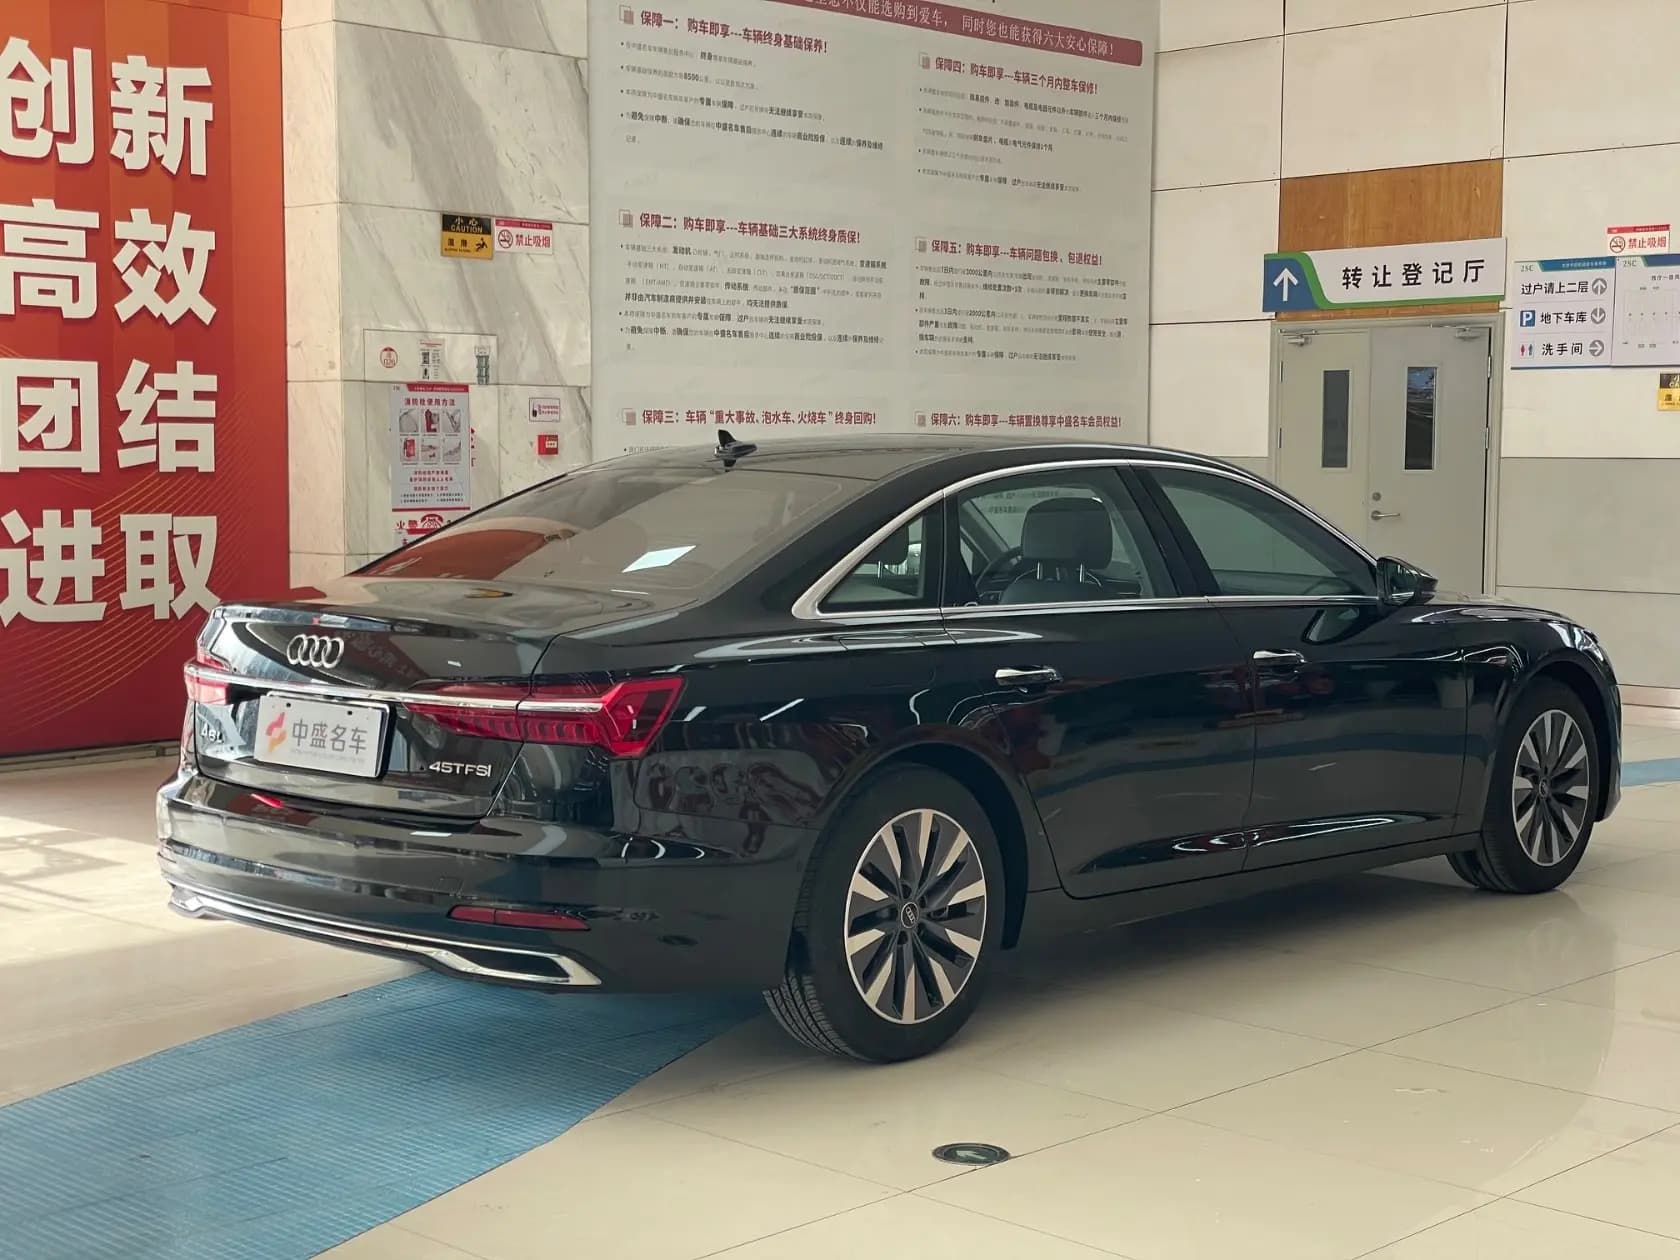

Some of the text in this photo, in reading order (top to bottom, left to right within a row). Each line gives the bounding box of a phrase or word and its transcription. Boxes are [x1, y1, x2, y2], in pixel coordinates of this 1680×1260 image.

[0, 36, 214, 176] 创新
[450, 224, 483, 233] CAUTION
[515, 234, 551, 248] 禁止吸烟
[1628, 236, 1667, 249] 禁止吸烟
[0, 198, 217, 327] 高效
[1341, 259, 1485, 290] 转让登记厅
[1520, 281, 1589, 295] 过户请上二层
[1522, 311, 1533, 326] P
[1540, 311, 1587, 325] 地下车库
[1541, 343, 1583, 356] 洗手间
[0, 358, 218, 474] 团结
[0, 509, 221, 624] 进取
[292, 718, 369, 755] 中盛名车
